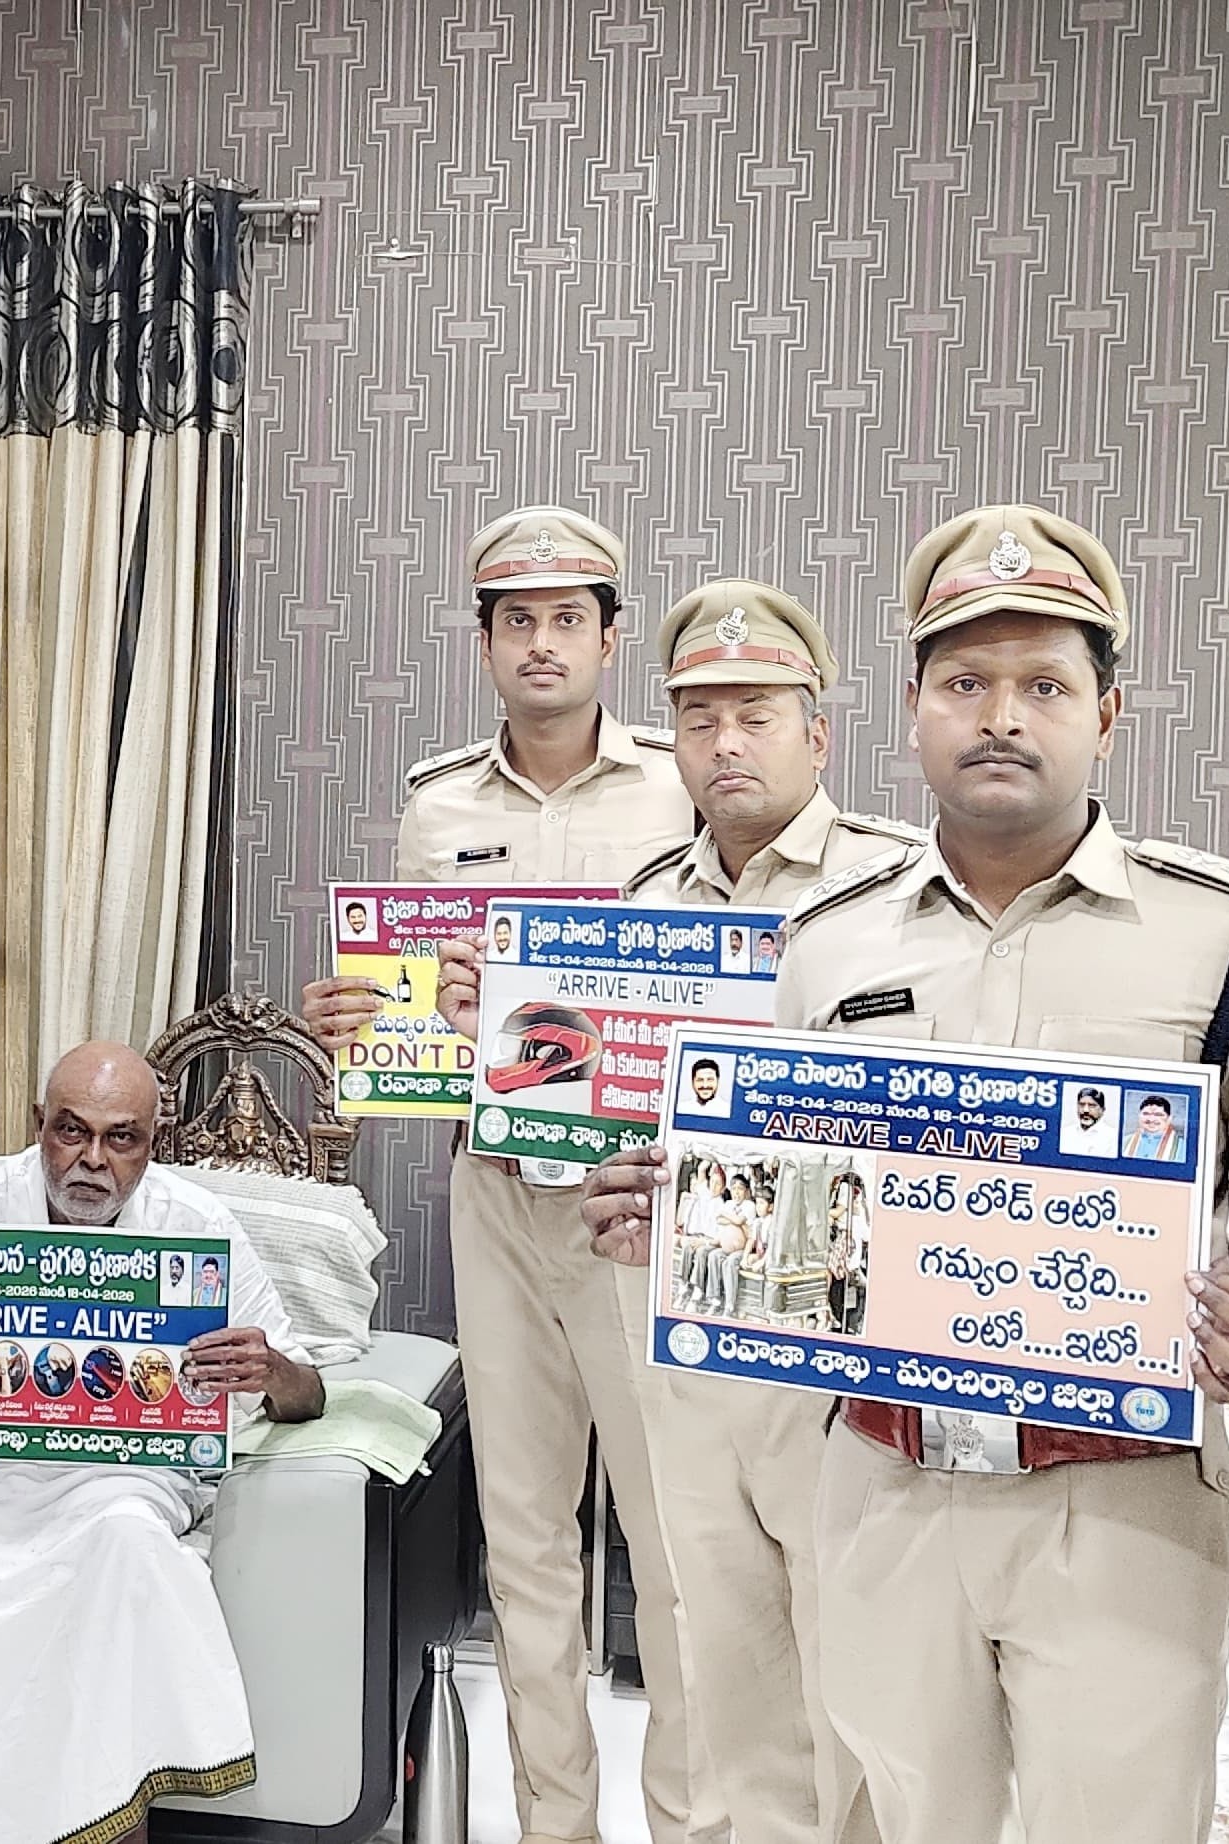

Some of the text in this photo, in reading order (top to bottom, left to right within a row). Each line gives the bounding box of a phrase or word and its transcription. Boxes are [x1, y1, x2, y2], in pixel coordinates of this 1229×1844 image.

[374, 1015, 426, 1041] మద్యం
[378, 1072, 442, 1095] రవాణా
[736, 1052, 788, 1087] ప్రజా
[793, 1056, 866, 1090] పాలన
[888, 1067, 954, 1102] ప్రగతి
[959, 1072, 1058, 1108] ప్రణాళిక
[776, 1094, 884, 1115] 13-04-2026
[933, 1109, 1047, 1131] 18-04-2026
[512, 1116, 566, 1142] రవాణా
[569, 1124, 606, 1152] శాఖ
[881, 1173, 957, 1213] ఓవర్
[966, 1178, 1033, 1221] లోడ్
[39, 1245, 86, 1284] ప్రగతి
[921, 1247, 1018, 1297] గమ్యం
[716, 1331, 805, 1368] రవాణా
[809, 1348, 871, 1383] శాఖ
[896, 1357, 1047, 1416] మంచిర్యాల
[1053, 1382, 1115, 1424] జిల్లా
[45, 1430, 143, 1463] మంచిర్యాల
[146, 1435, 186, 1463] జిల్లా
